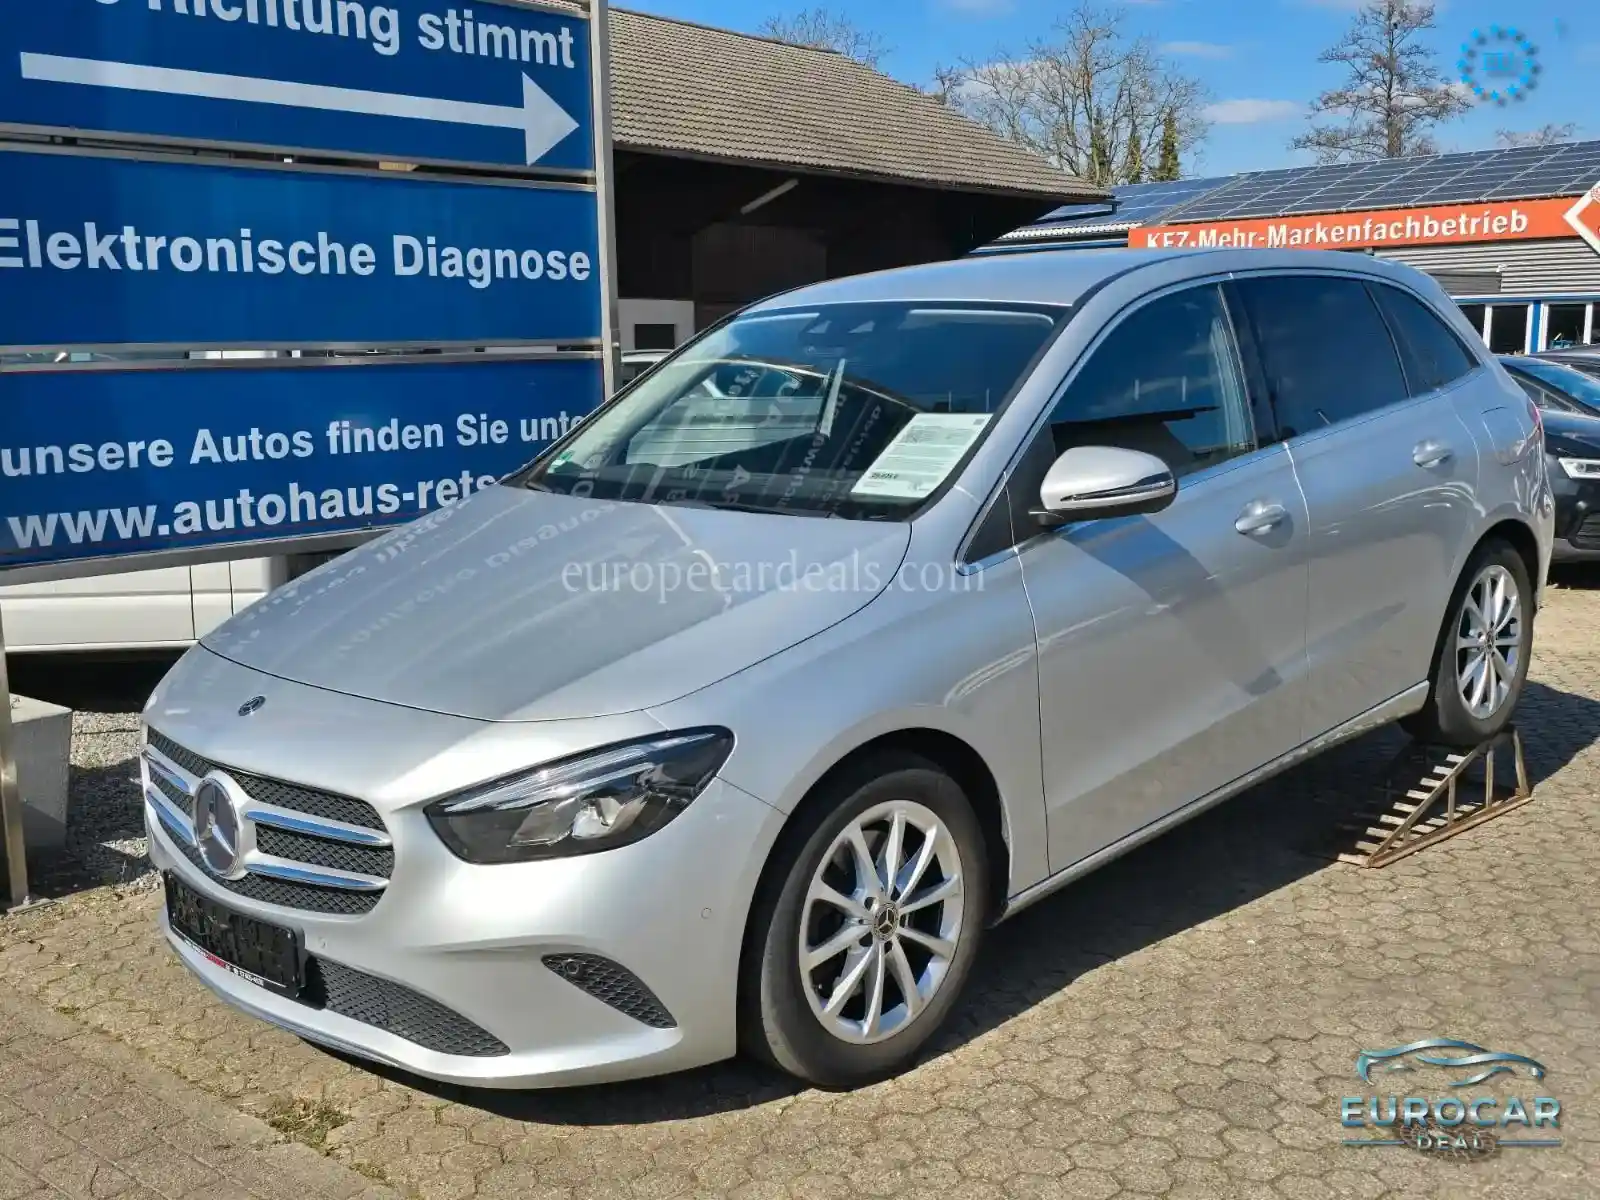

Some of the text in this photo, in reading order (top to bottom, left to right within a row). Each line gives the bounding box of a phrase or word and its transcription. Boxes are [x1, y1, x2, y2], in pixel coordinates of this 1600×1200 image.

[148, 0, 576, 68] chtung stimmt
[0, 218, 591, 289] Elektronische Diagnose
[2, 437, 175, 477] unsere
[189, 426, 315, 465] Autos
[326, 417, 445, 455] finden
[456, 413, 510, 447] Sie
[7, 470, 512, 549] www.autohaus-rets
